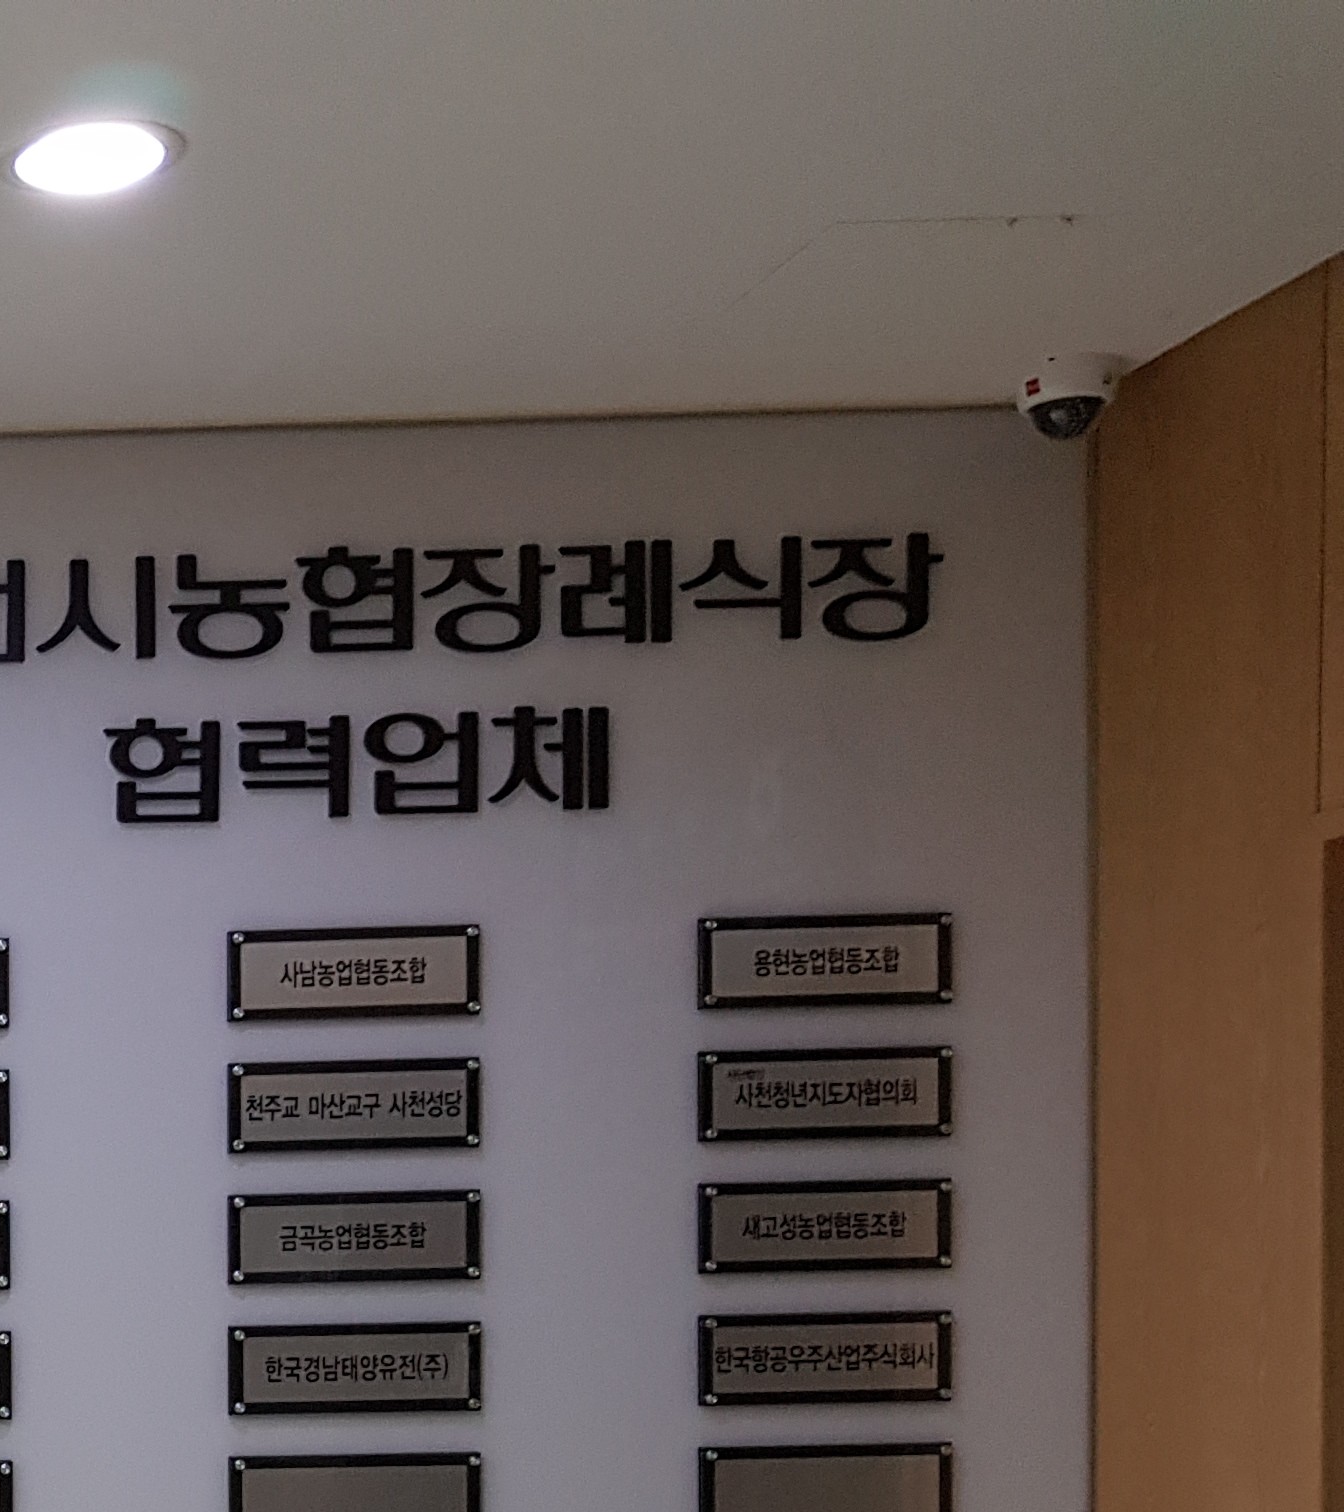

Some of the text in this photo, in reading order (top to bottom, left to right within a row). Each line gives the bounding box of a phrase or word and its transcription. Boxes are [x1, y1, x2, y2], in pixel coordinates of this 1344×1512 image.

[103, 705, 610, 823] 협력업체
[280, 957, 427, 988] 사남농업협동조합
[754, 946, 900, 977] 용현농업협동조합
[245, 1090, 462, 1121] 천주교 마산교구 사천성당
[735, 1078, 918, 1108] 사천청년지도자협의회
[279, 1222, 427, 1251] 금곡농업협동조합
[742, 1214, 906, 1240] 새고성농업협동조합
[265, 1353, 449, 1383] 한국경남태양유전(주)
[715, 1342, 934, 1373] 한국항공우주산업주식회사
